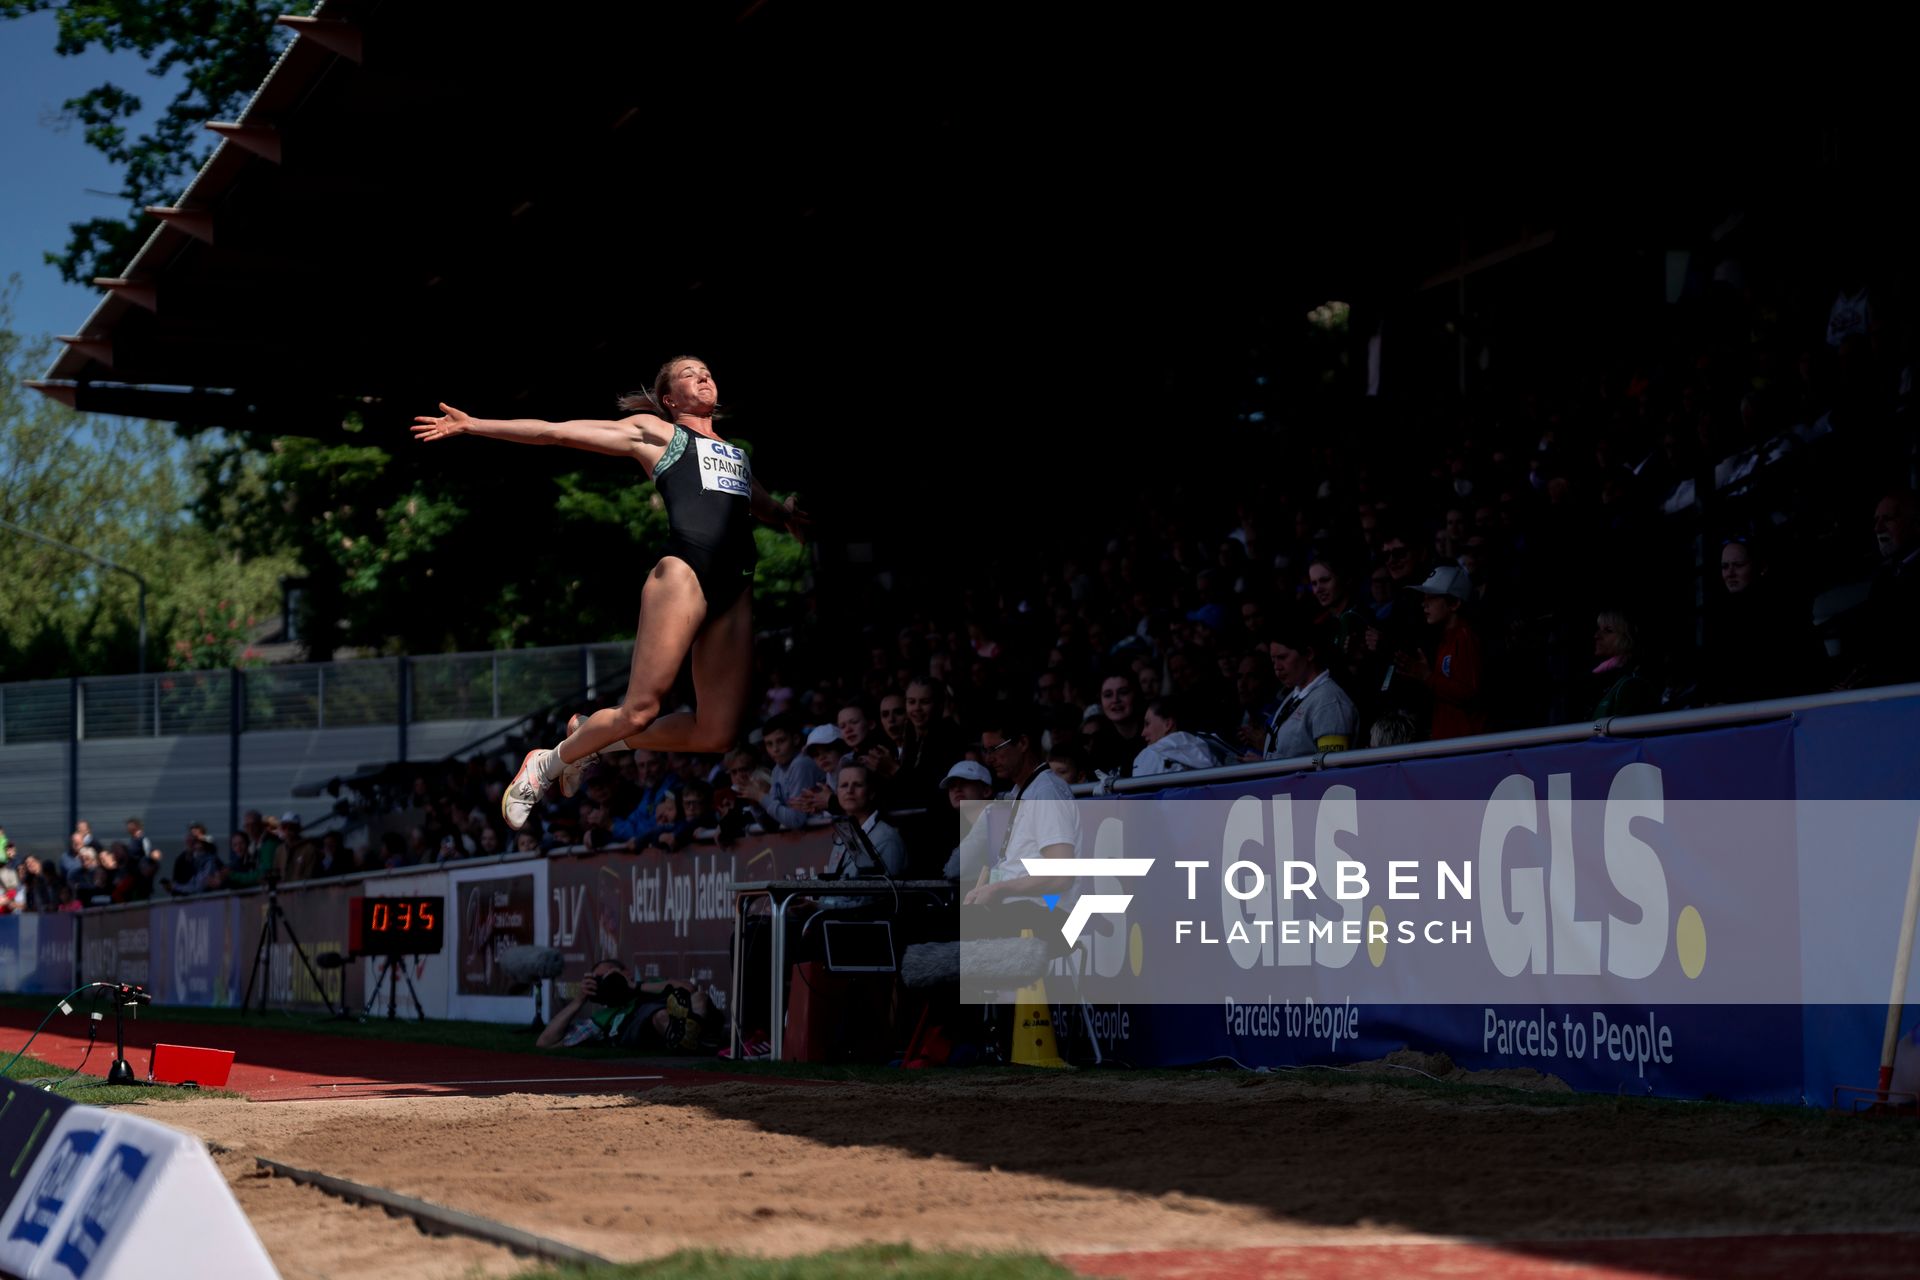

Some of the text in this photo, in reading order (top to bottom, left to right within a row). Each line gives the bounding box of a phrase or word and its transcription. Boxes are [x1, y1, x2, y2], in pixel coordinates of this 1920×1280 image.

[703, 456, 750, 480] STAINTO
[711, 442, 742, 460] GLS
[629, 864, 661, 924] Jetzt
[663, 862, 689, 937] App
[1225, 995, 1359, 1052] Parcels to People
[1483, 1007, 1673, 1078] Parcels to People
